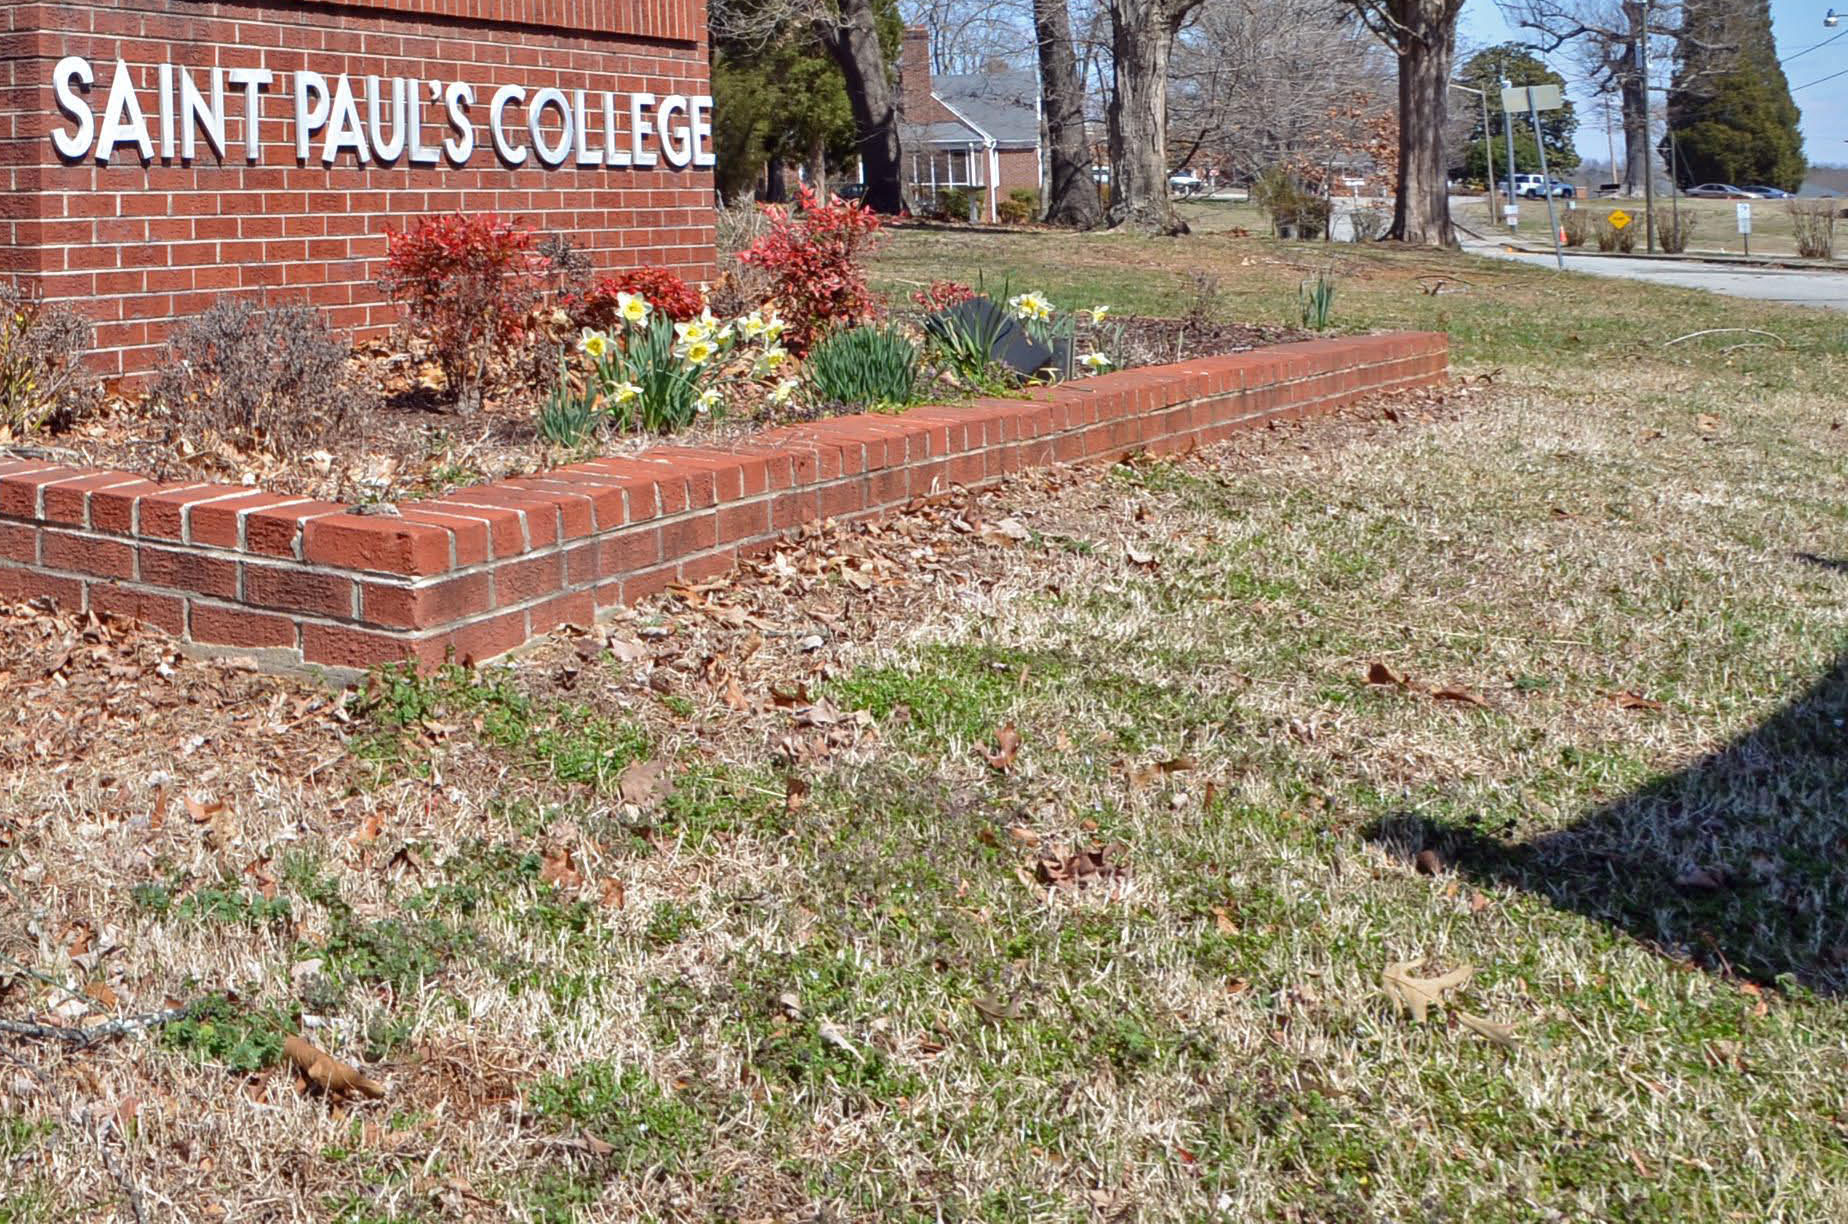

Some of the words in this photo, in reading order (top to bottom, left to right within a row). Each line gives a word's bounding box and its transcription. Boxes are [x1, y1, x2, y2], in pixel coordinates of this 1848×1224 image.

[51, 55, 273, 163] SAINT
[293, 70, 475, 165] PAUL'S
[489, 84, 717, 168] COLLEGE
